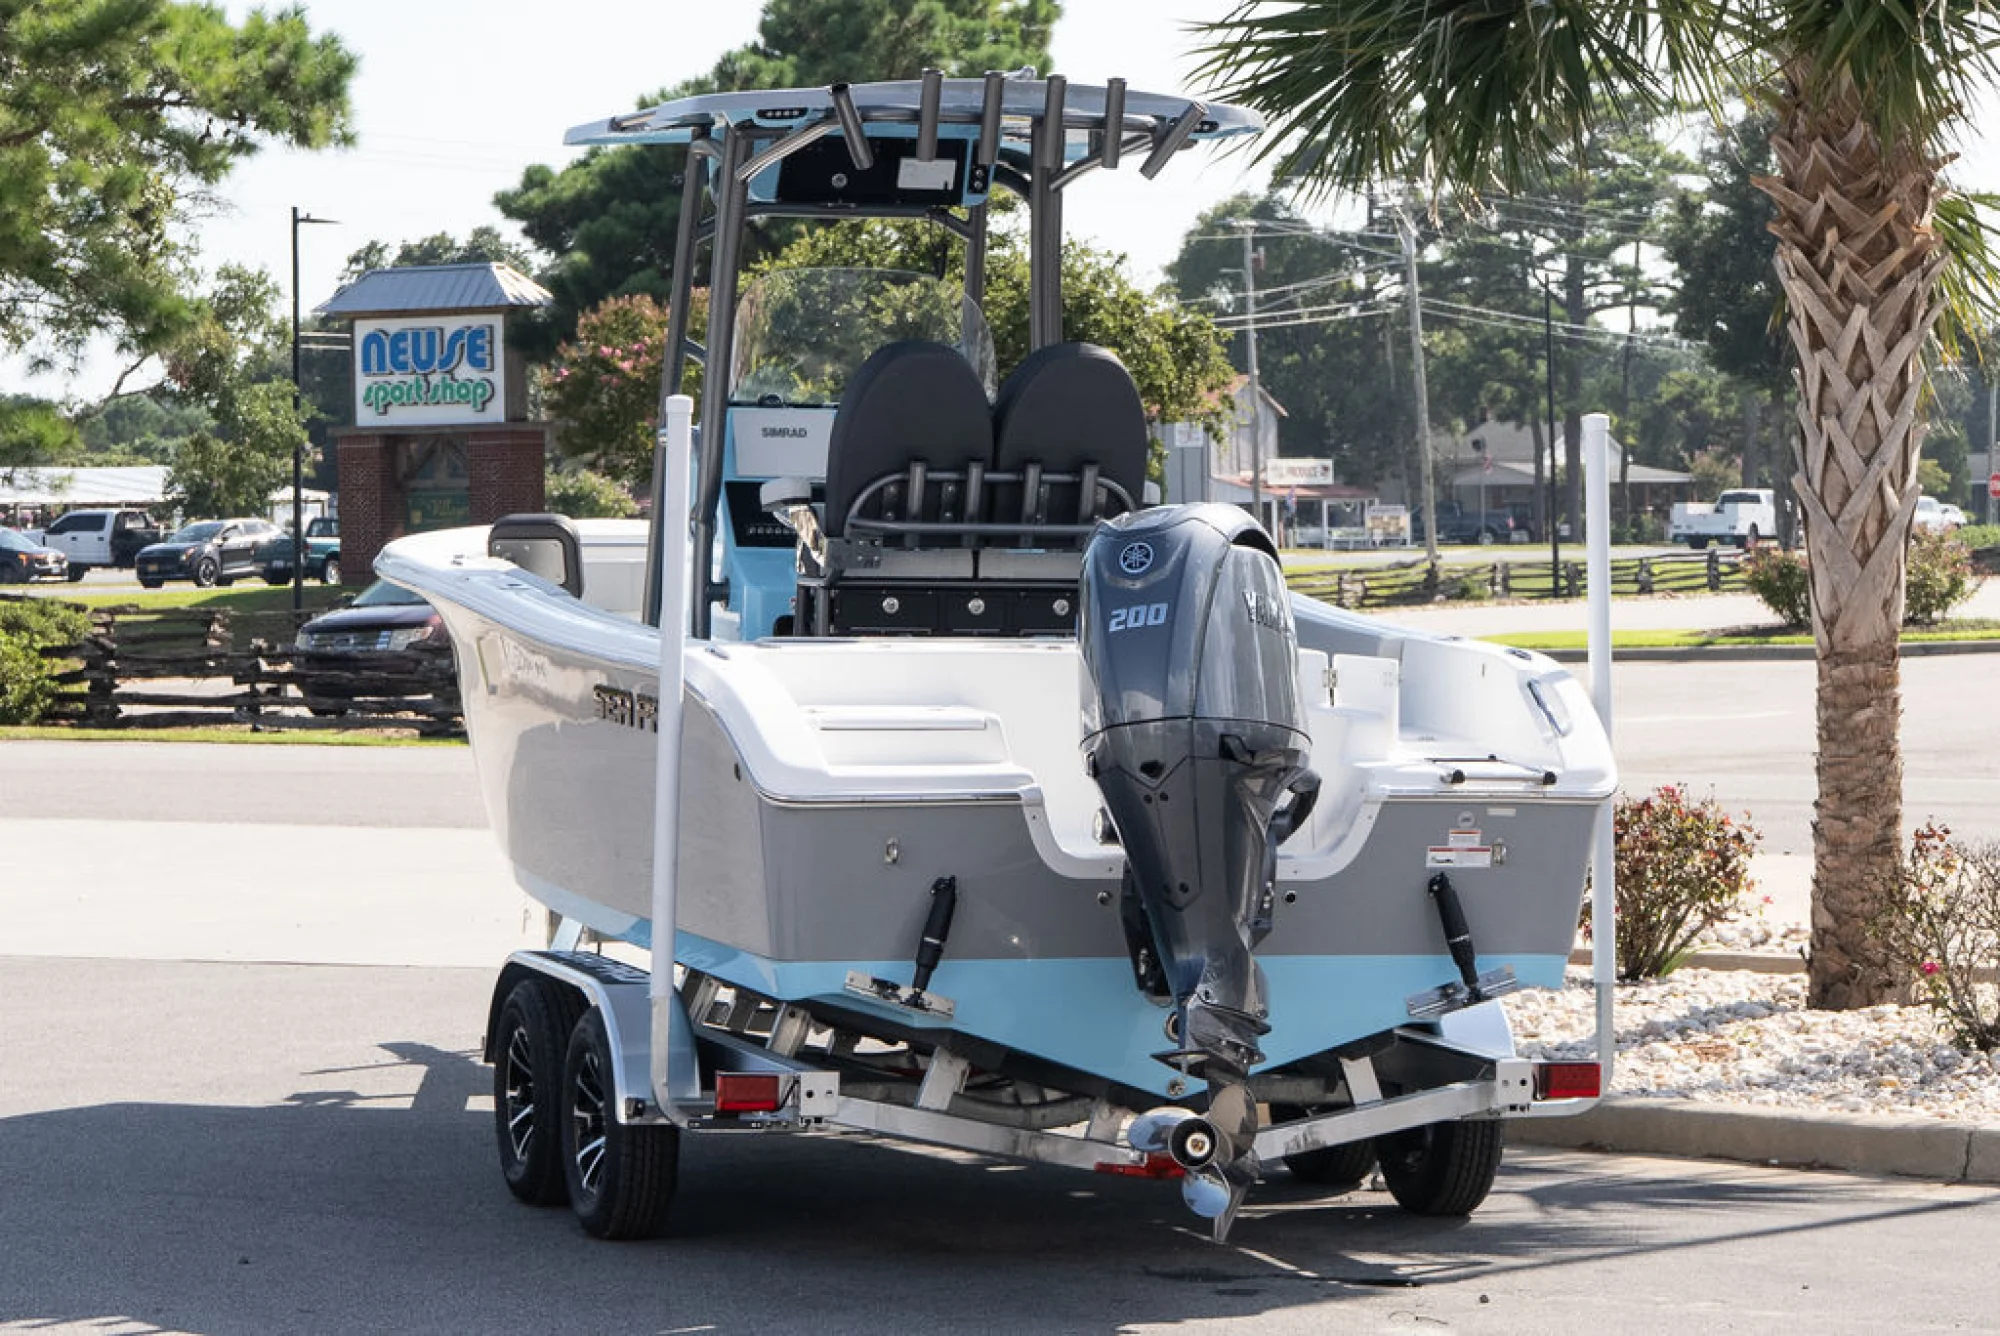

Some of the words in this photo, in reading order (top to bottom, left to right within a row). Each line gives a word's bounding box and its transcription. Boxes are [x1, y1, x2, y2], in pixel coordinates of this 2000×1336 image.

[361, 326, 491, 374] NEUSE
[362, 376, 423, 413] sport
[428, 376, 490, 411] shop
[761, 427, 808, 438] SIMRAD
[1109, 602, 1168, 632] 200
[593, 684, 635, 727] SEA
